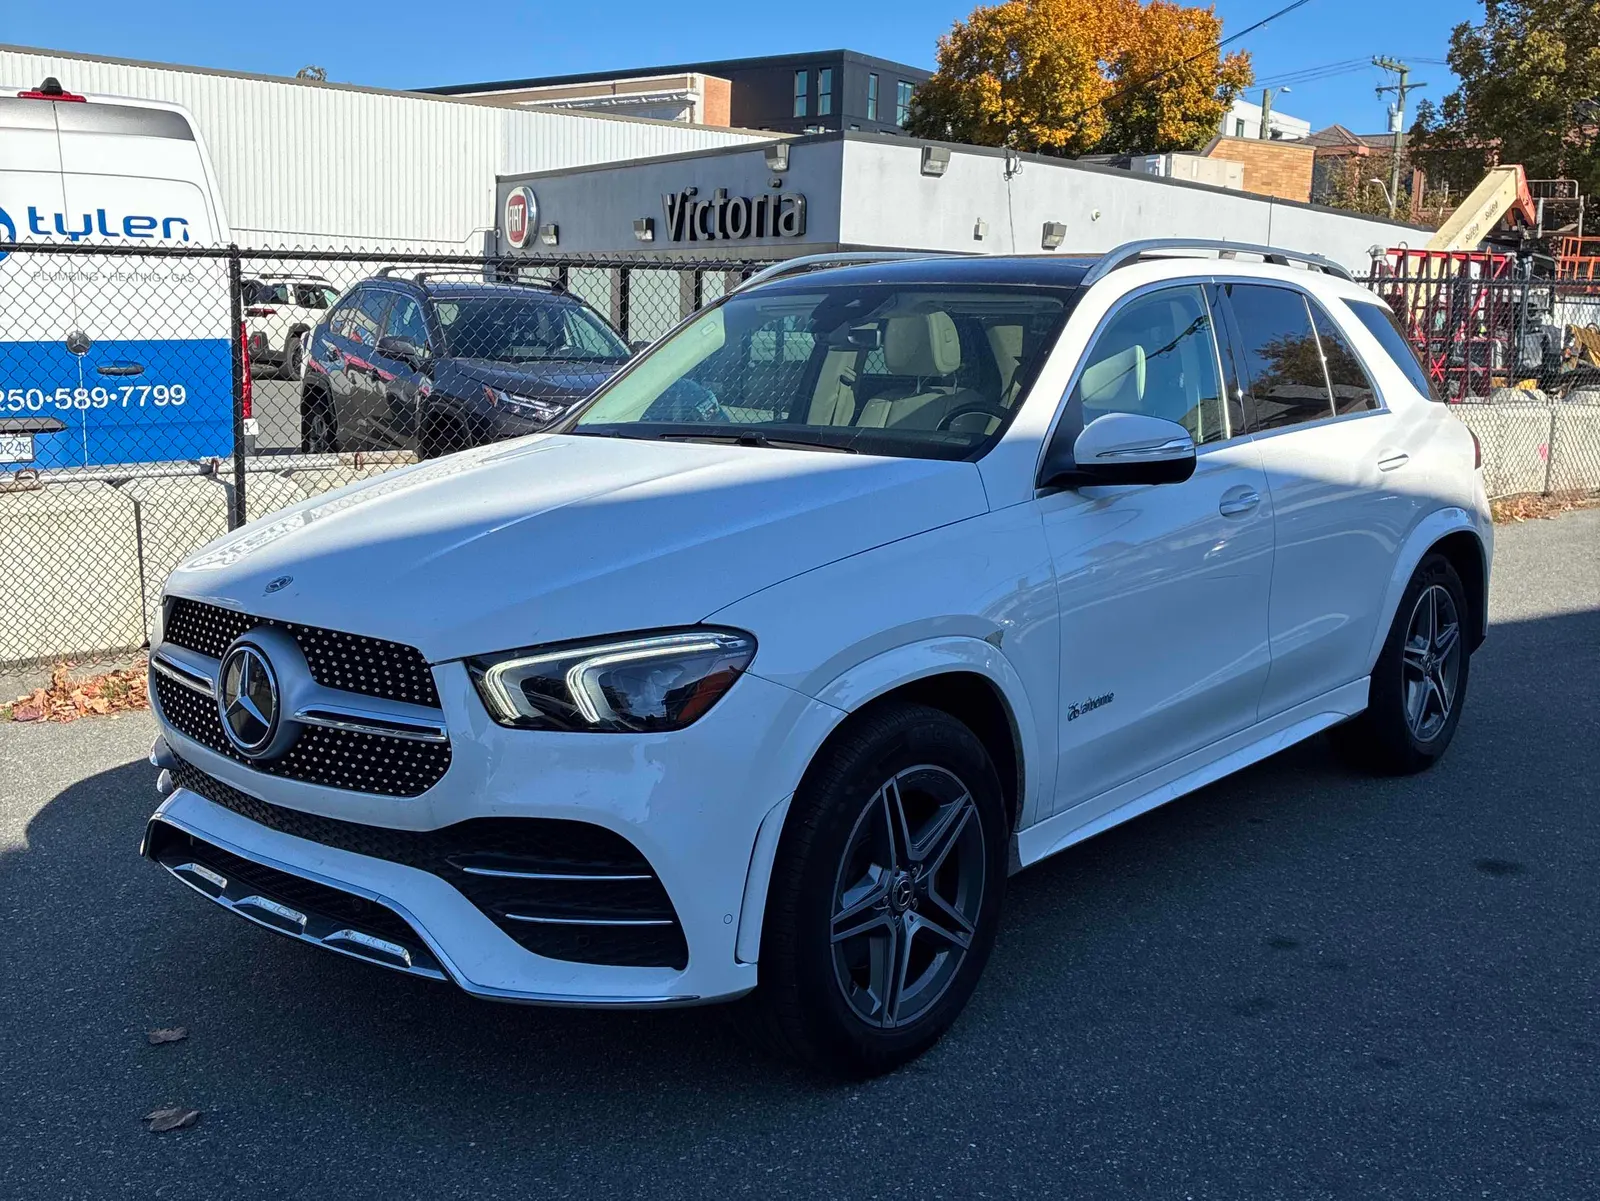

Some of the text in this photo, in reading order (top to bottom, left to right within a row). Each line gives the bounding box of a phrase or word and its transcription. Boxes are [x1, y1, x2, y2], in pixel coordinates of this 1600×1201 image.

[27, 206, 190, 242] tyler
[508, 203, 525, 232] FIAT
[661, 177, 807, 242] Victoria
[33, 270, 195, 284] PLUMBING HEATING GAS
